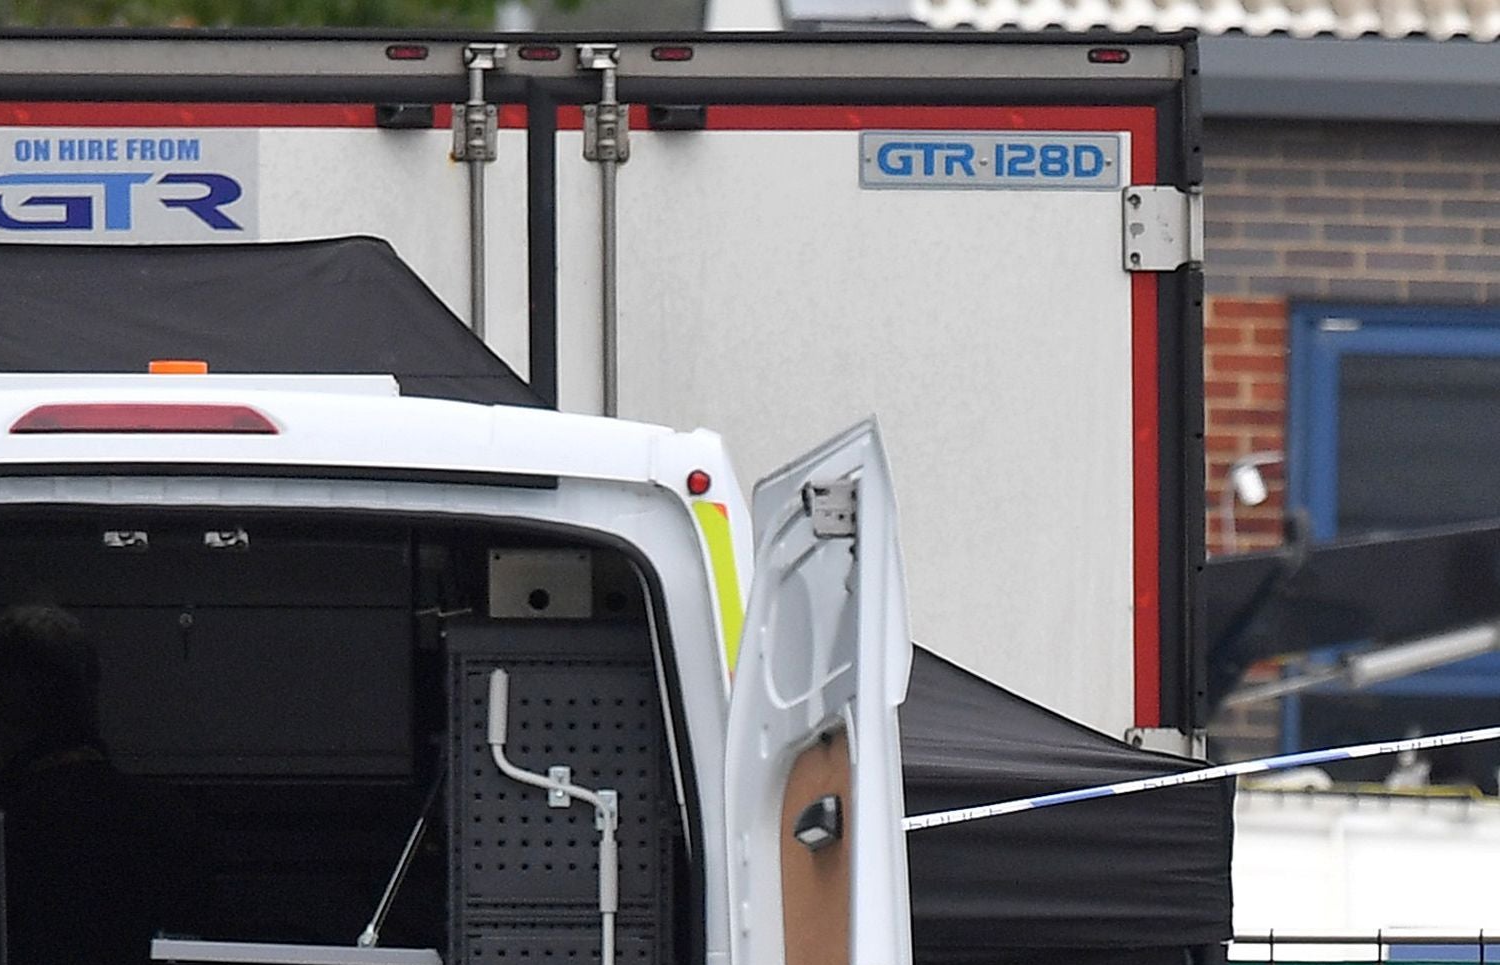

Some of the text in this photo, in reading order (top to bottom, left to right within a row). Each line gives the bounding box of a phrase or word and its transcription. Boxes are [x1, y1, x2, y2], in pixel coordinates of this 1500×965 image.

[14, 138, 200, 162] ON HIRE FROM
[877, 142, 1104, 177] GTR 128D
